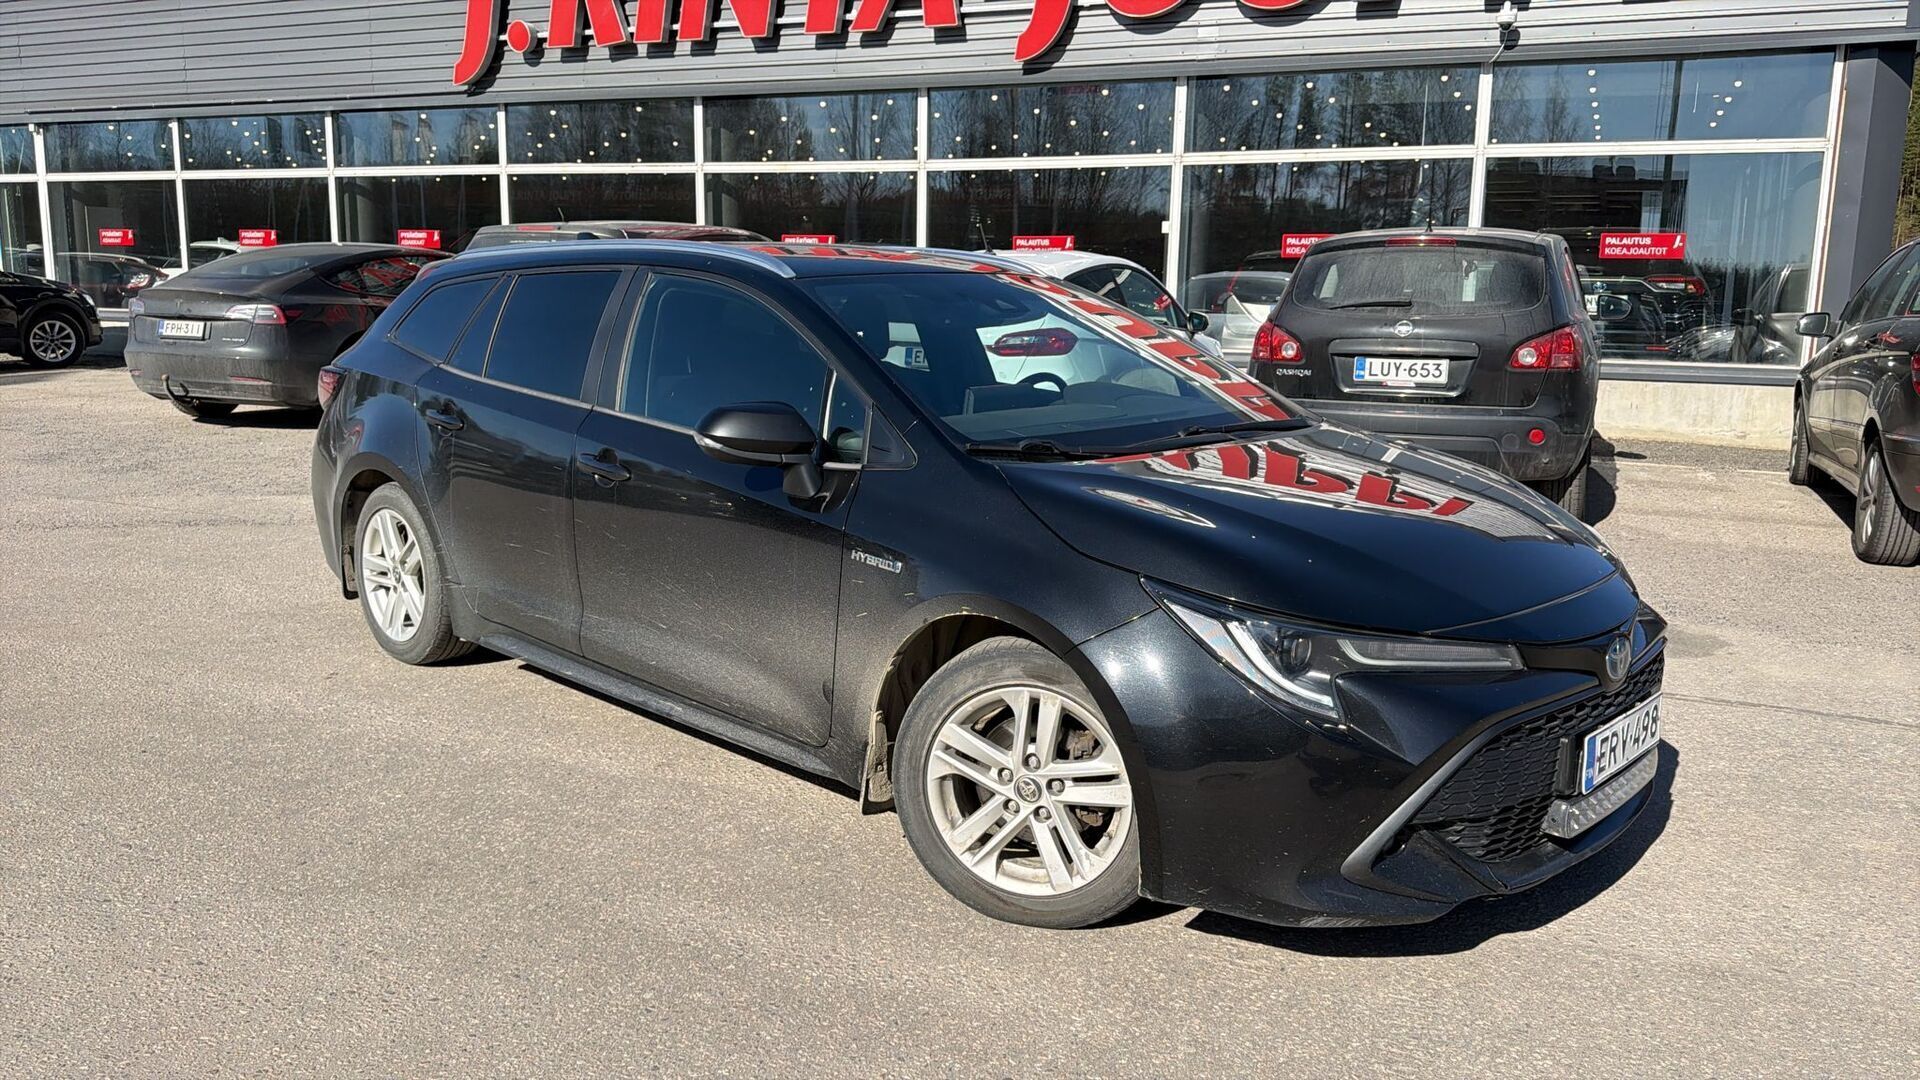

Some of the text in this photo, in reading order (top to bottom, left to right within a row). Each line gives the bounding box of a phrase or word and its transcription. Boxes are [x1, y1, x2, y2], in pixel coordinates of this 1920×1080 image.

[1605, 237, 1652, 245] PALAUTUS
[1604, 247, 1667, 255] KOEAJOAUTOT
[164, 322, 200, 335] FPH-311
[1276, 368, 1312, 377] QASHQAI
[1368, 361, 1443, 379] LUY-653
[851, 549, 894, 571] HYBRID
[1597, 703, 1659, 775] ERV-498
